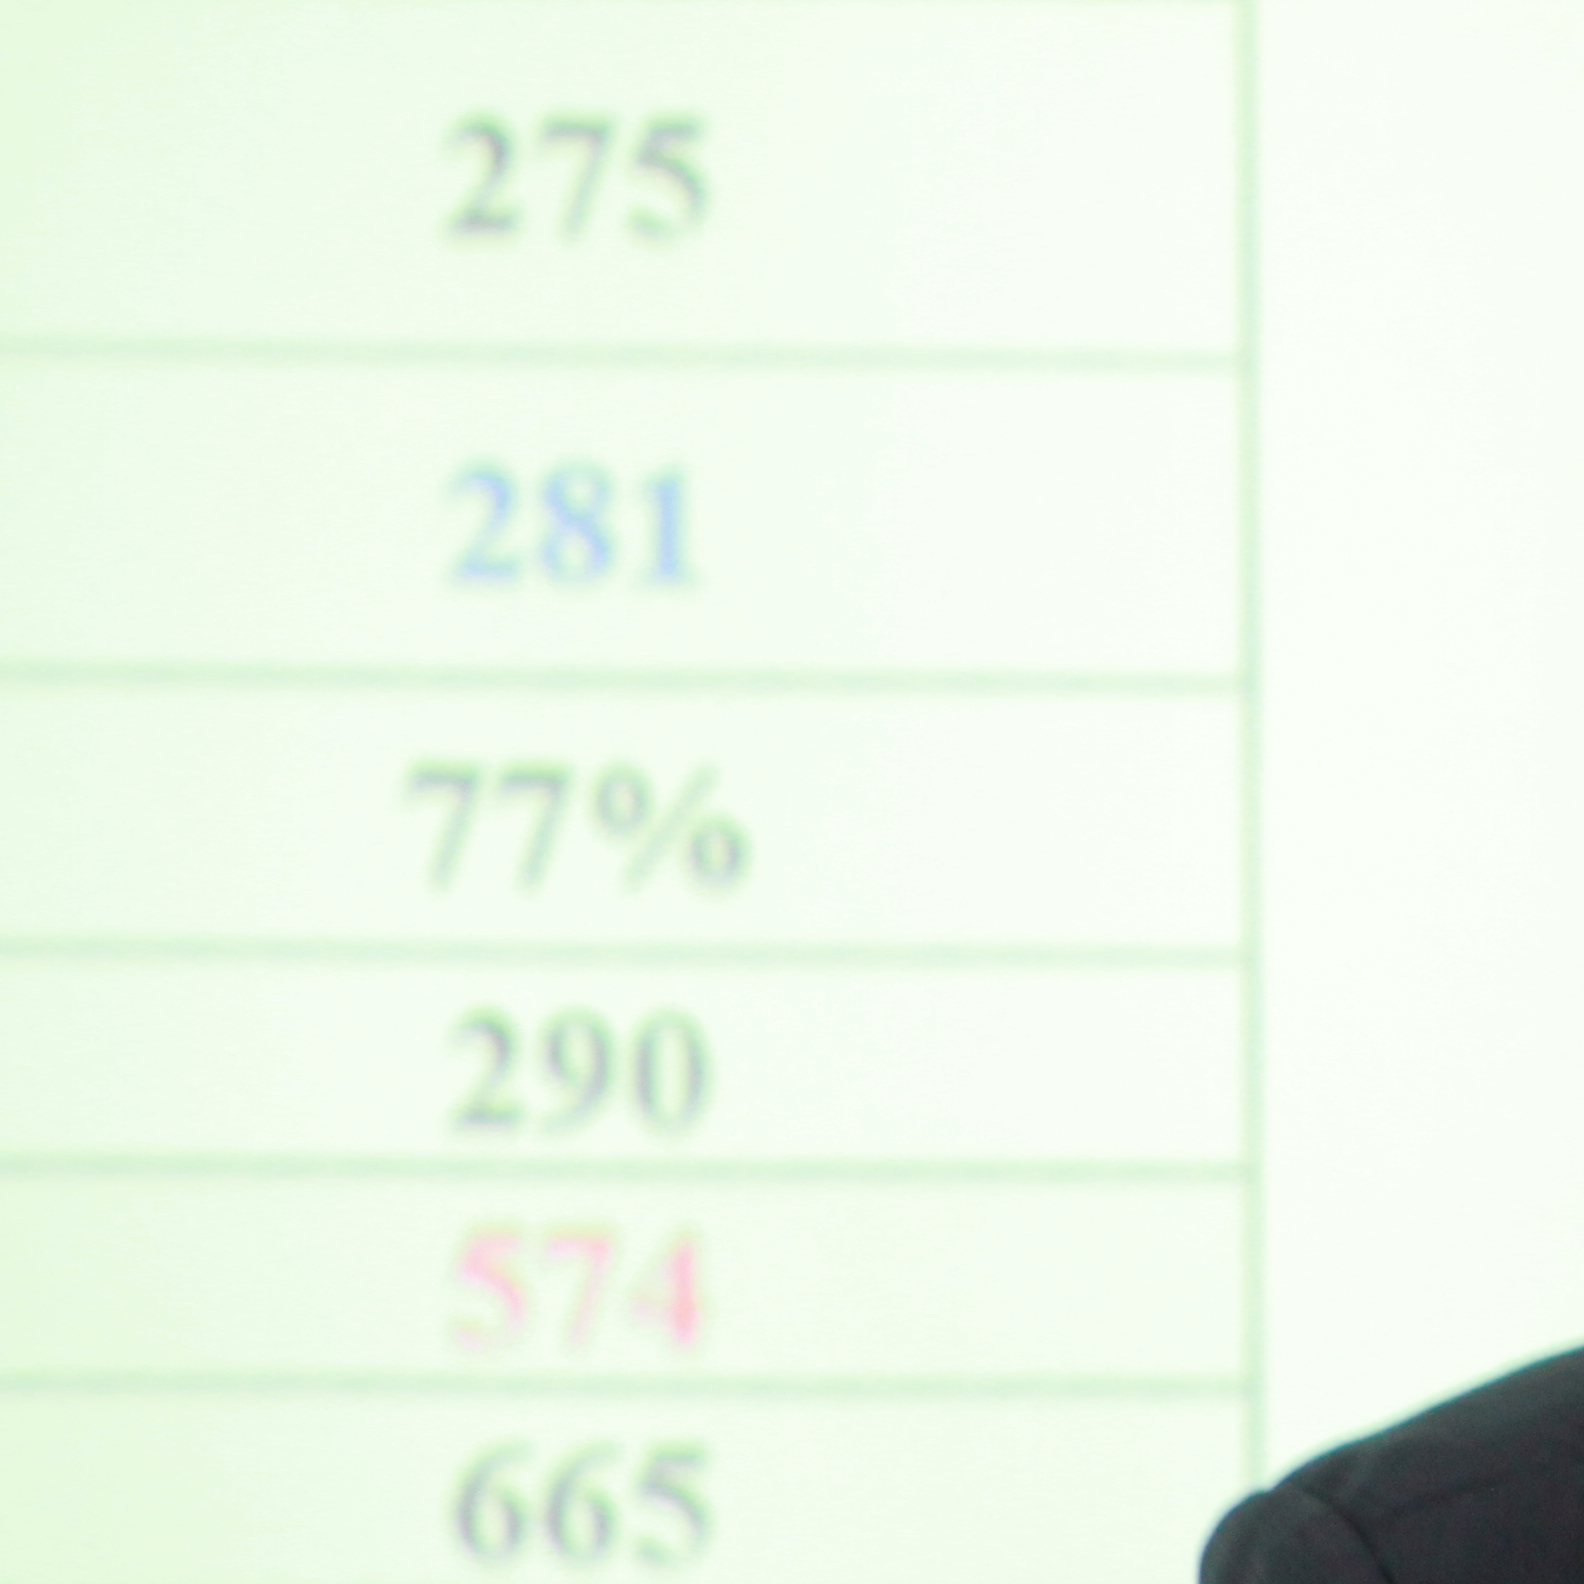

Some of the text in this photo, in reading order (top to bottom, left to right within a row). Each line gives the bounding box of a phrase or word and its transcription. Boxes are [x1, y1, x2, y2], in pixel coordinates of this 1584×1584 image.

[442, 110, 710, 244] 275
[446, 458, 698, 588] 281
[402, 758, 754, 894] 77%
[450, 1006, 712, 1134] 290
[450, 1222, 708, 1350] 574
[450, 1440, 714, 1568] 665
